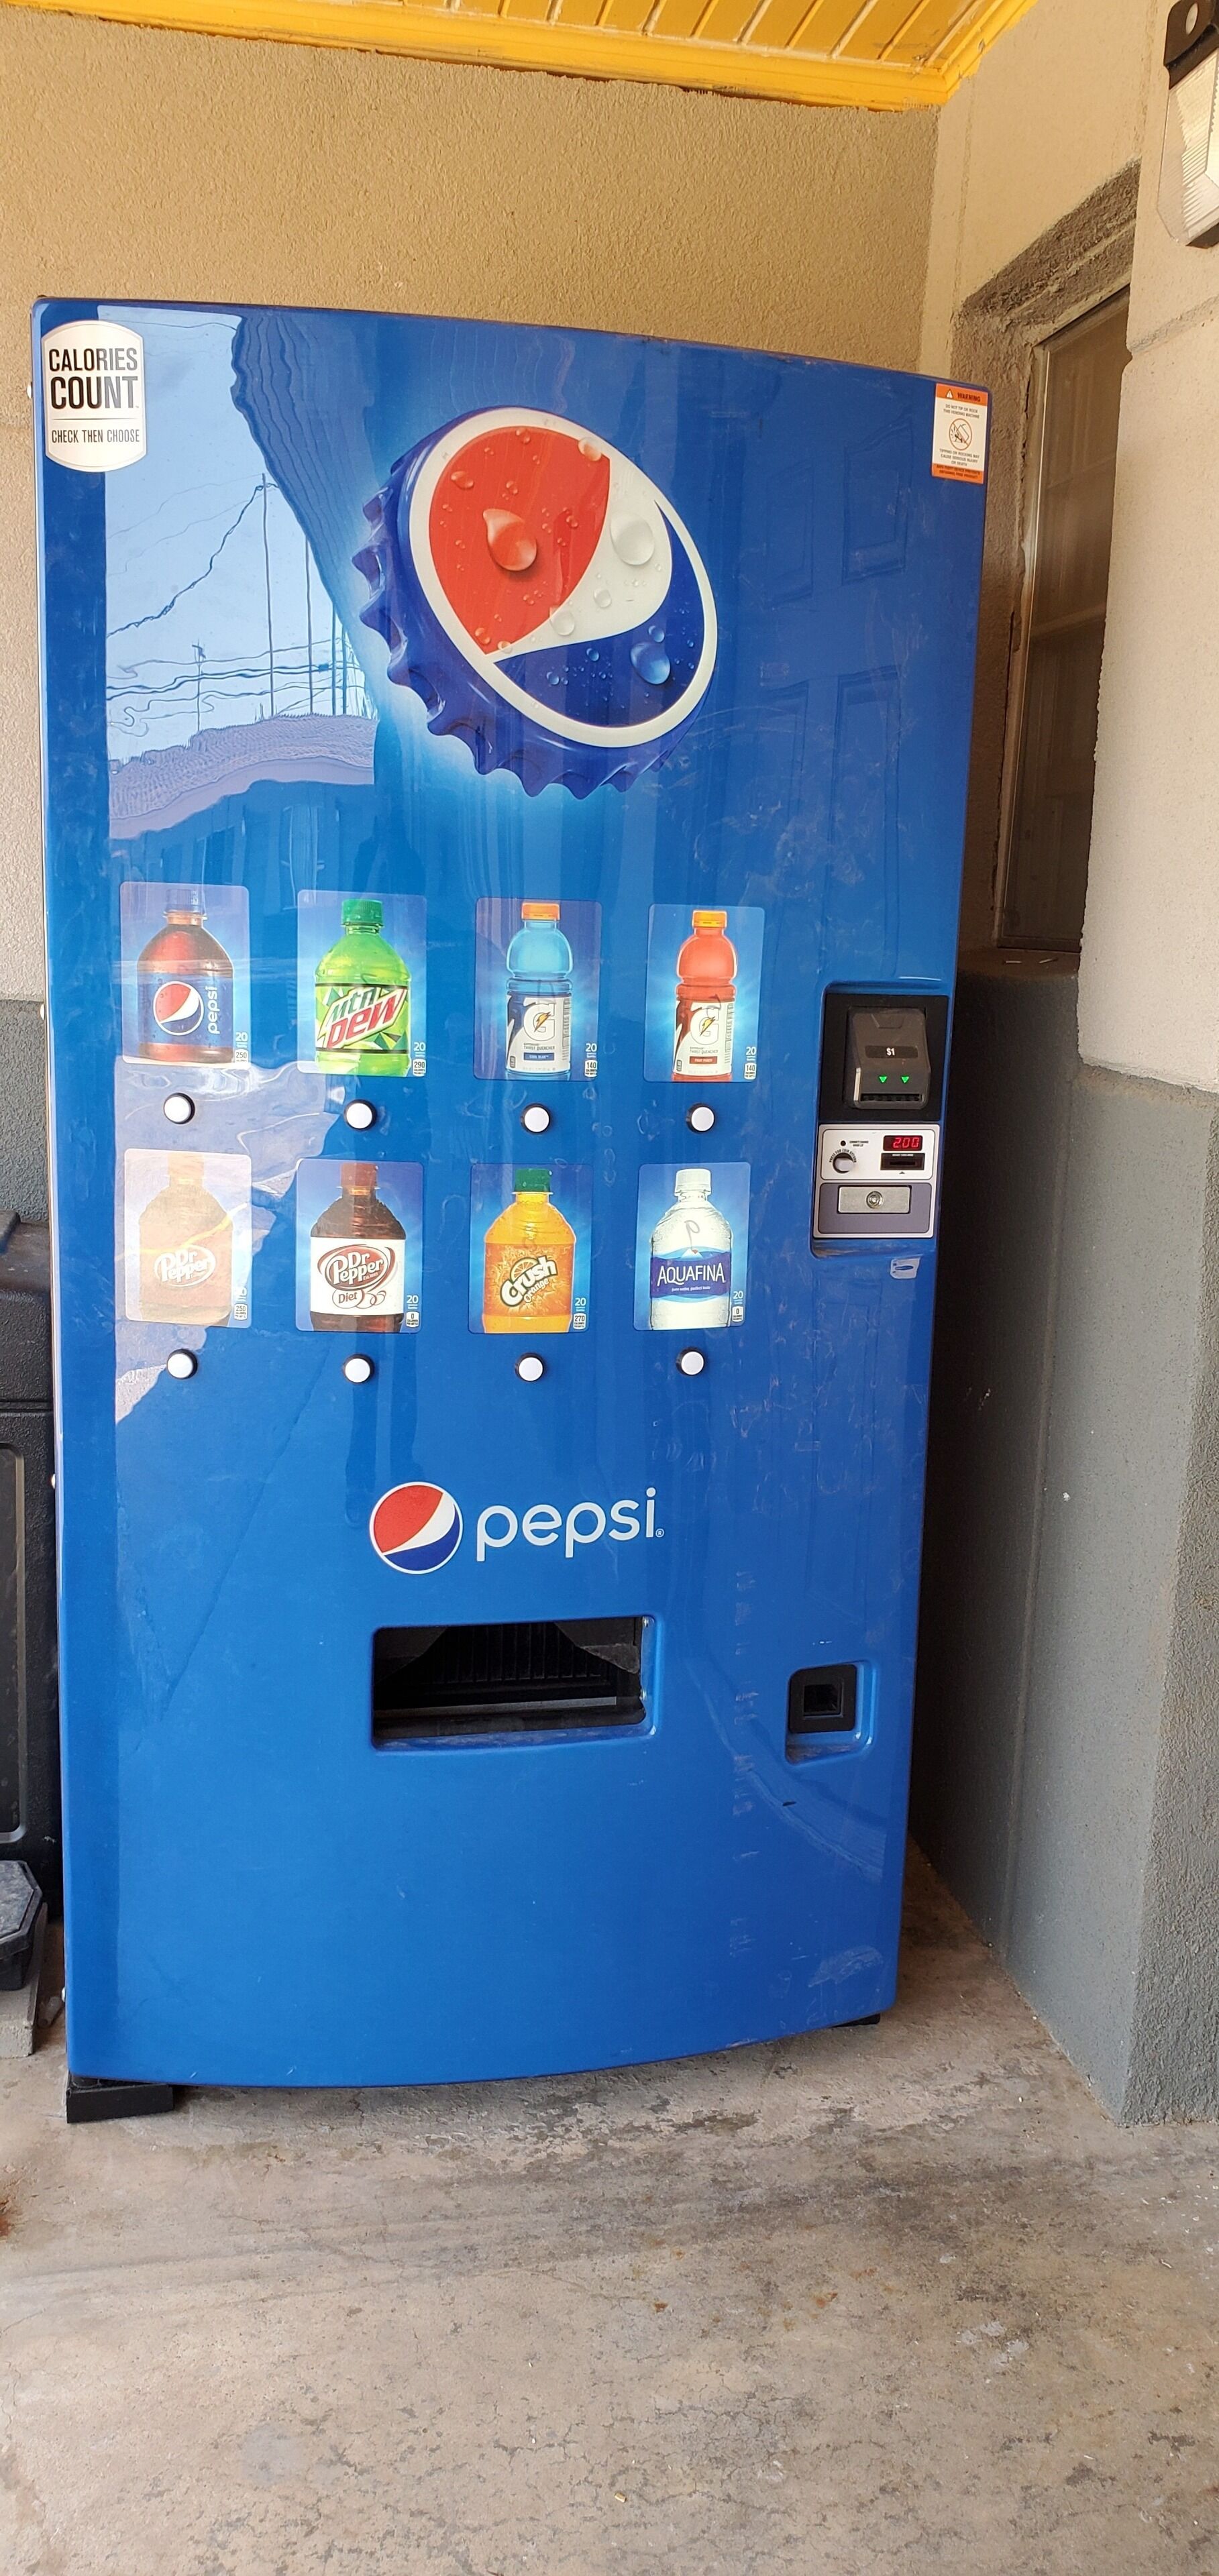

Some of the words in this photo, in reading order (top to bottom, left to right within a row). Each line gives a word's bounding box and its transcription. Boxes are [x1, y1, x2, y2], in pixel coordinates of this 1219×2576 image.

[49, 347, 138, 372] CALORIES
[51, 376, 138, 409] COUNT
[957, 392, 981, 402] WARNING
[52, 430, 78, 443] CHECK
[82, 429, 103, 443] THEN
[107, 429, 140, 443] CHOOSE
[205, 985, 221, 1034] pepsi
[235, 1032, 248, 1042] 20
[413, 1042, 426, 1051] 20
[586, 1043, 597, 1052] 20
[746, 1046, 757, 1055] 20
[886, 1047, 896, 1056] S1
[175, 1248, 197, 1267] Dr
[348, 1252, 370, 1269] Dr
[160, 1252, 209, 1283] Pepper
[331, 1255, 384, 1285] Pepper
[657, 1263, 725, 1287] AQUAFINA
[500, 1255, 558, 1307] Crush
[338, 1292, 358, 1303] Diet
[523, 1278, 549, 1303] Orange
[733, 1291, 743, 1299] 20
[407, 1295, 419, 1303] 20
[575, 1298, 586, 1306] 20
[476, 1487, 656, 1562] pepsi
